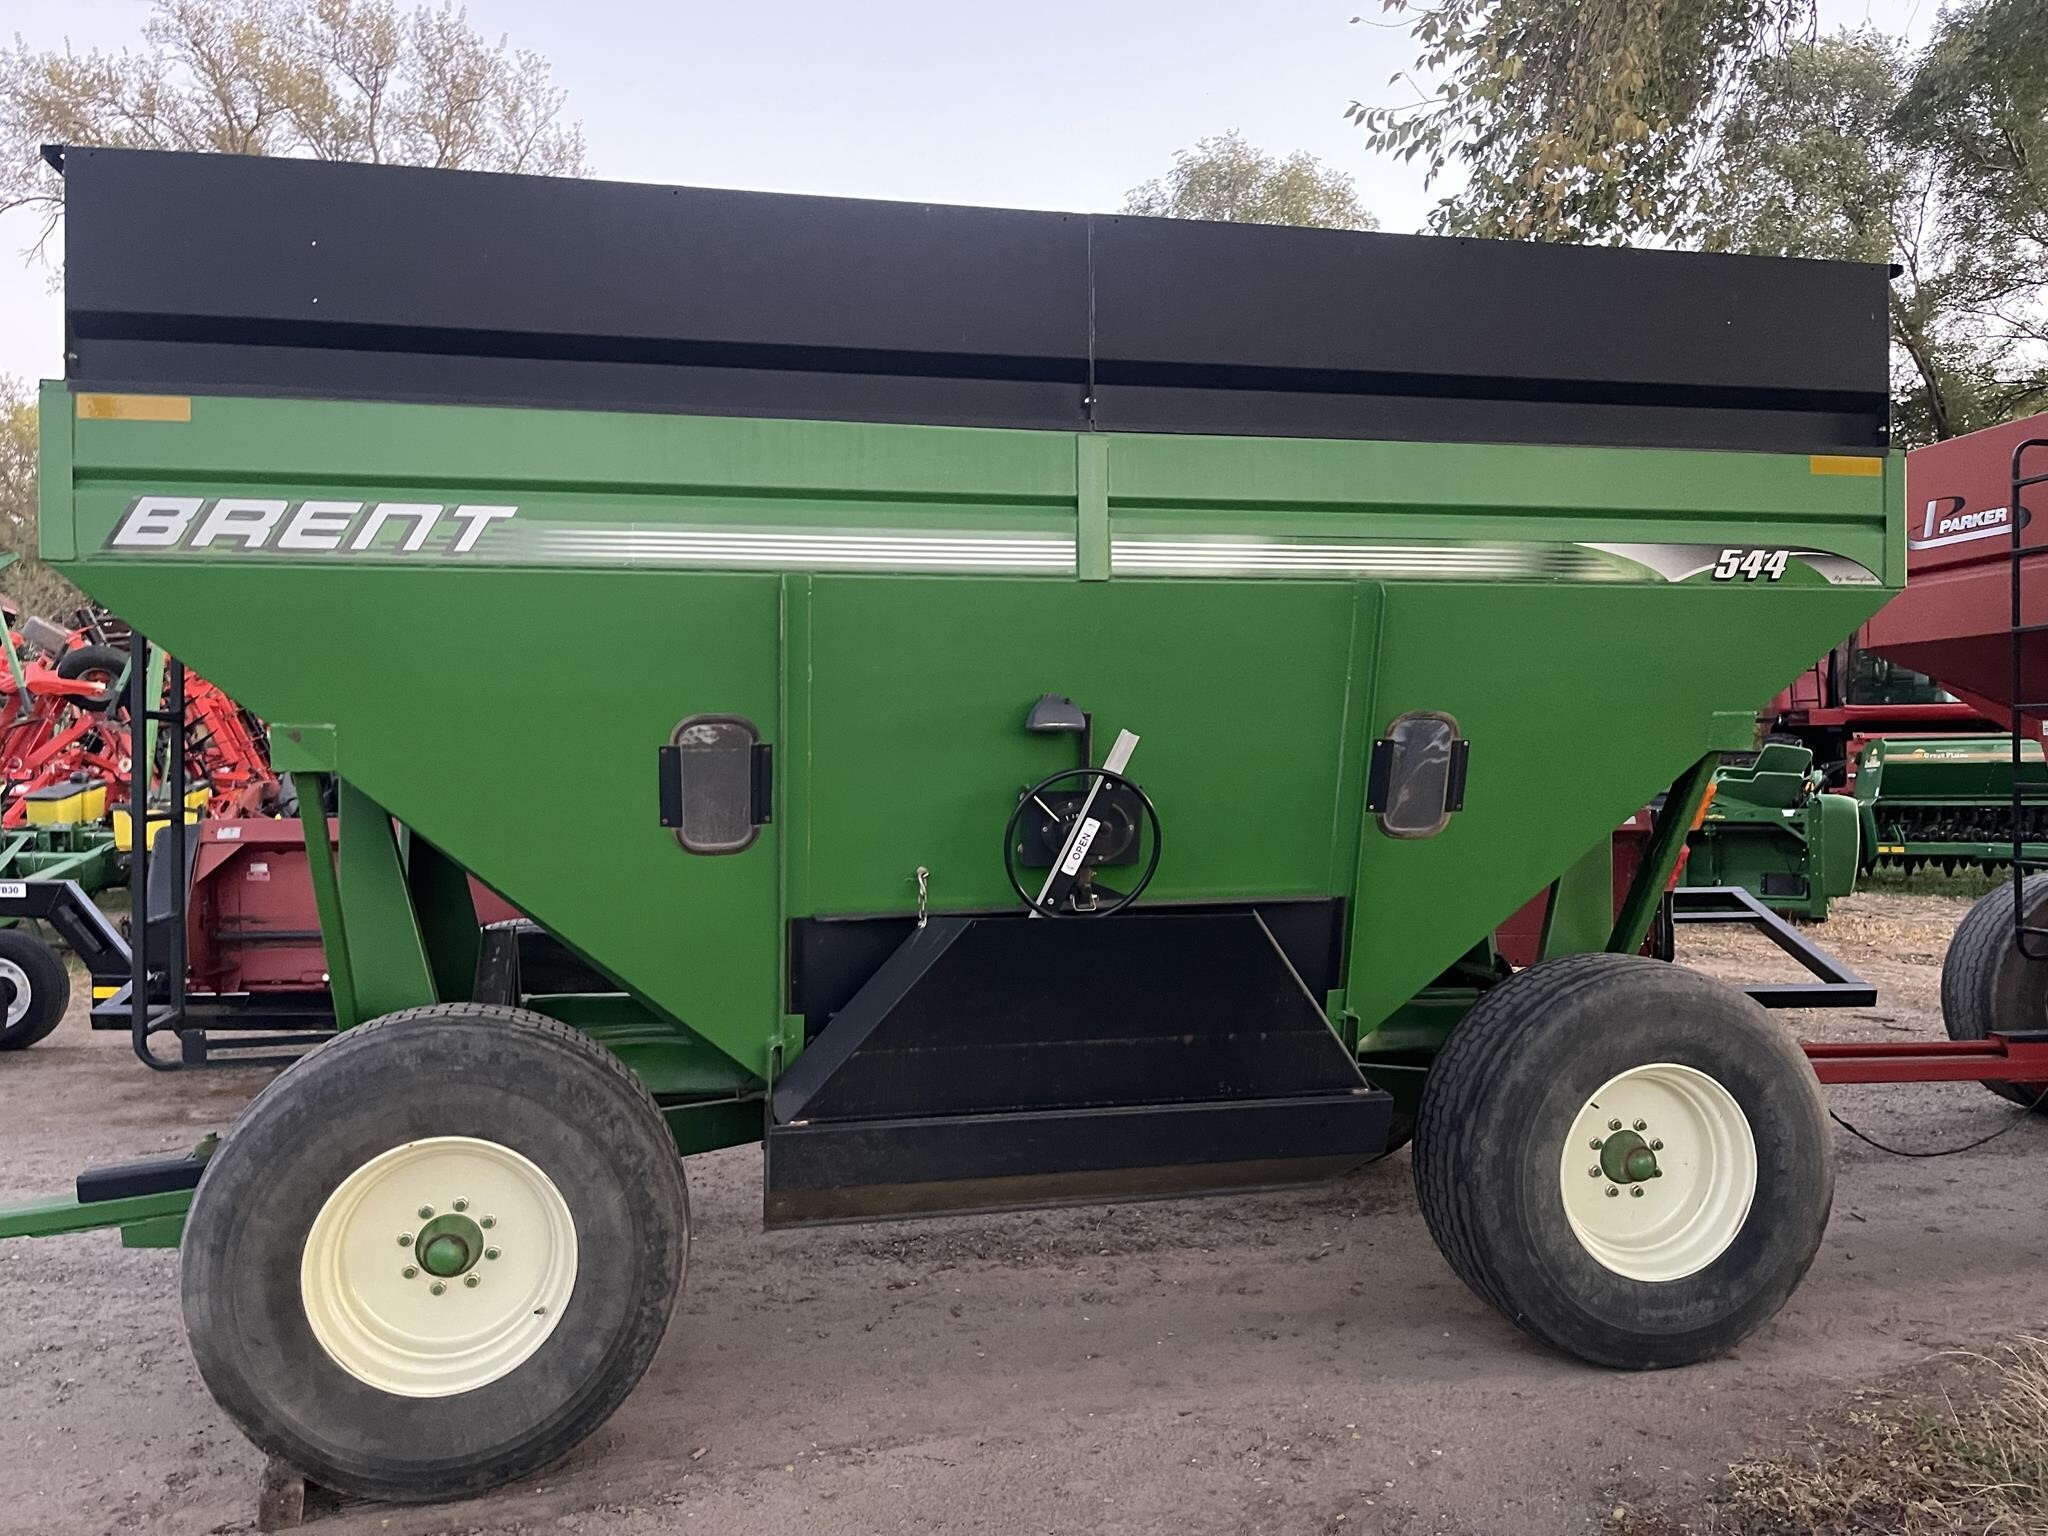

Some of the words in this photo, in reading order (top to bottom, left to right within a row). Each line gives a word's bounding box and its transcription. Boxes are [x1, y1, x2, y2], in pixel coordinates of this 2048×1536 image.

[106, 496, 519, 553] BRENT
[1939, 507, 2008, 534] PARKER
[1713, 550, 1790, 580] 544
[1072, 832, 1091, 860] OPEN
[0, 886, 19, 894] B30
